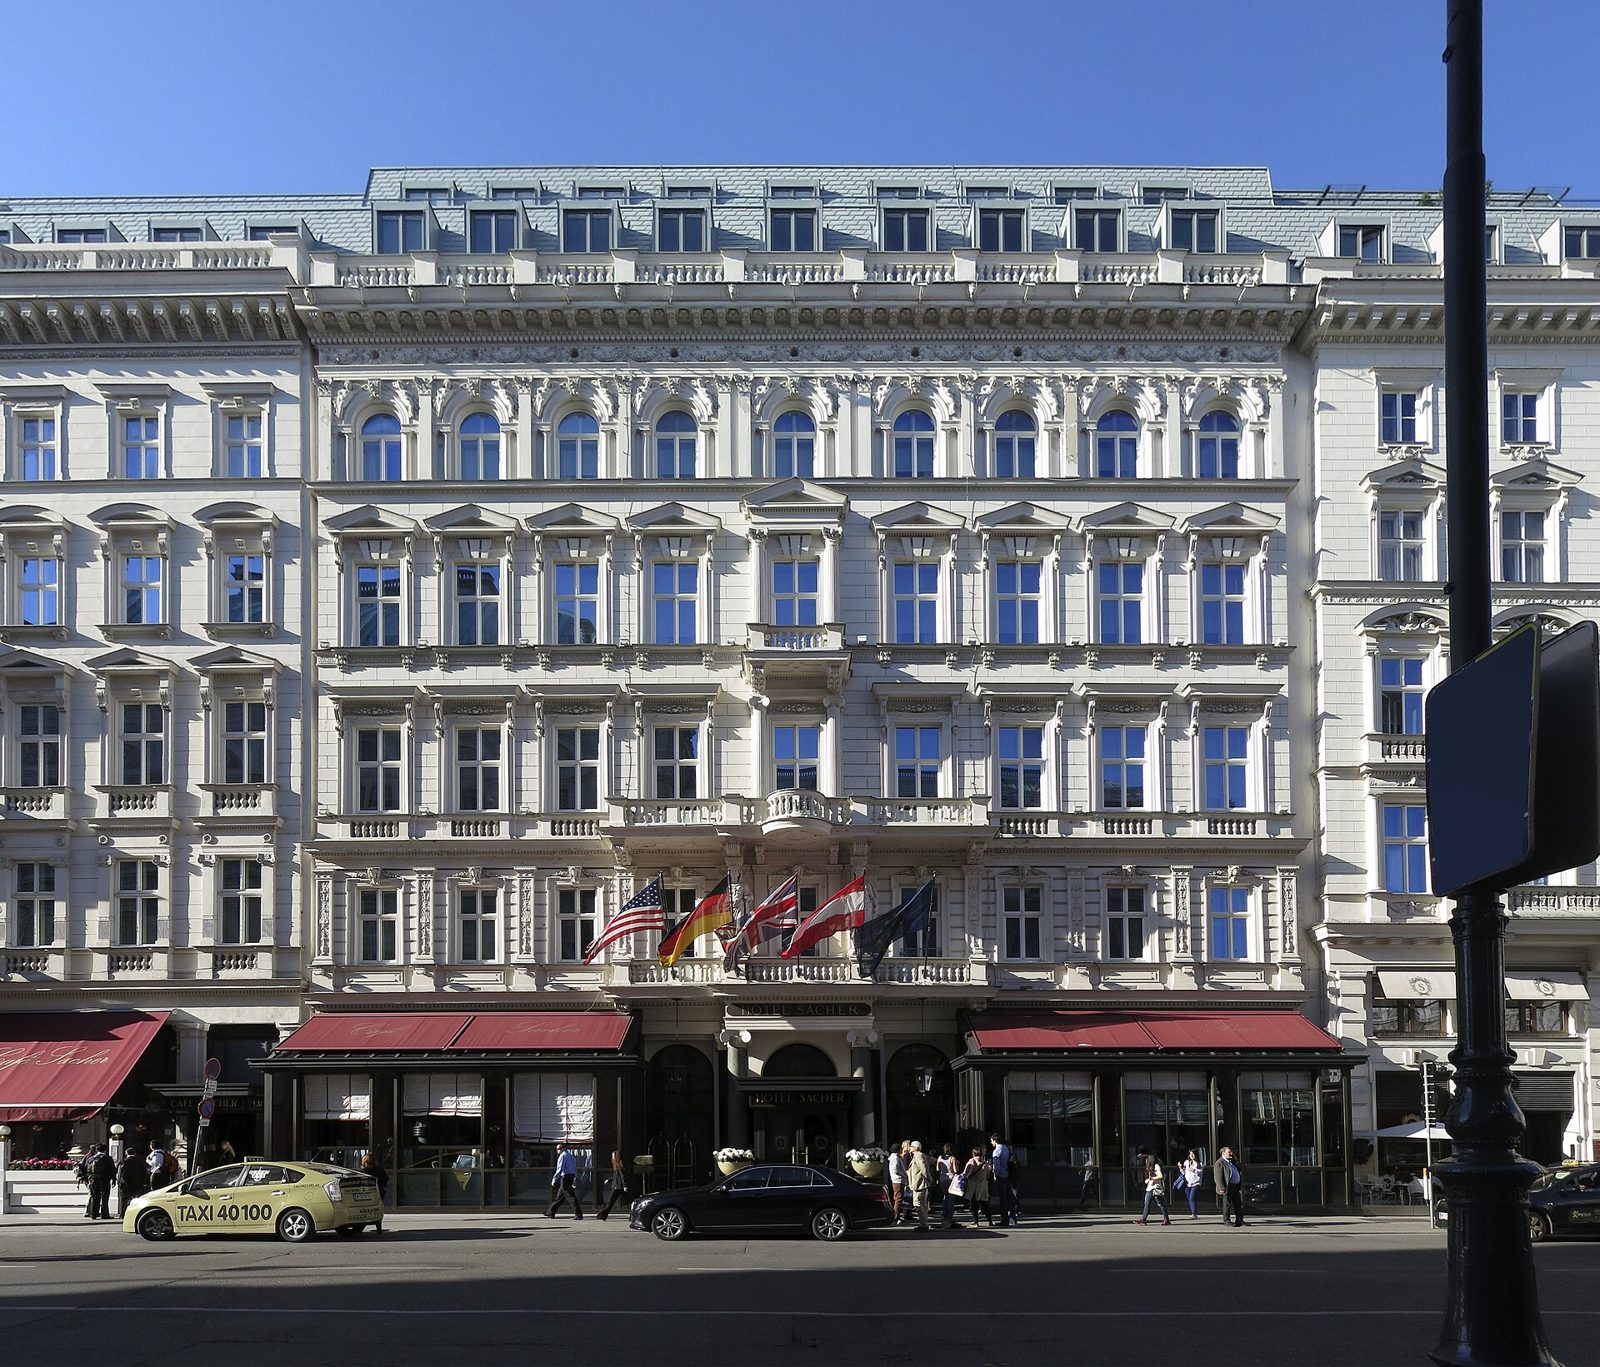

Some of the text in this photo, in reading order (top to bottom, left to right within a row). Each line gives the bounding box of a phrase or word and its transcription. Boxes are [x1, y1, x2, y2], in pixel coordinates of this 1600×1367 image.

[742, 1004, 859, 1015] HOTEL SACHER
[36, 1045, 110, 1065] Sacher
[755, 1093, 845, 1103] HOTEL SACHER
[177, 1204, 273, 1221] TAXI 40100
